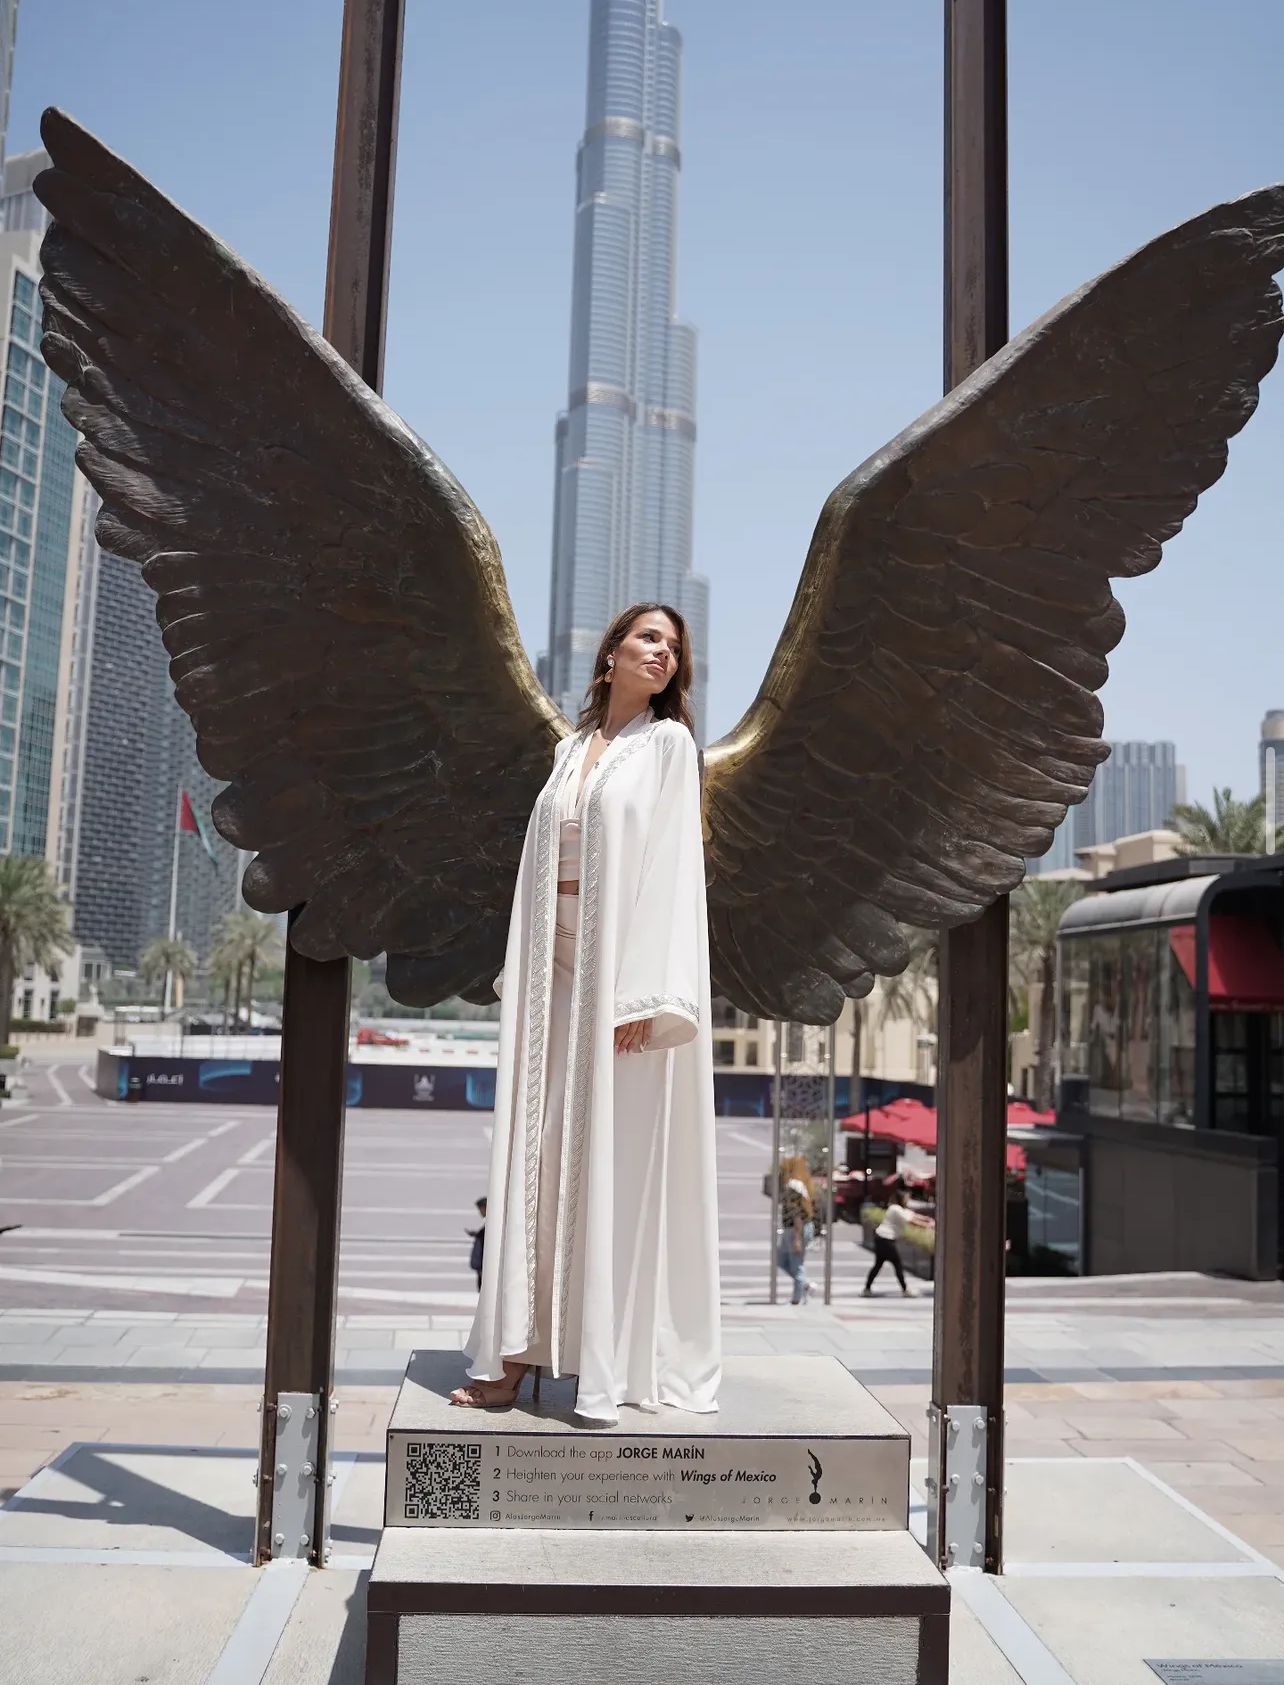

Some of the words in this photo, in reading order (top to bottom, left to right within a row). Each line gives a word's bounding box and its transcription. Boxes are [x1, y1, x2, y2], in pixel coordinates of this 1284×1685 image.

[495, 1445, 500, 1457] 1
[507, 1445, 566, 1459] Download
[569, 1446, 587, 1459] the
[589, 1449, 613, 1462] app
[616, 1447, 658, 1460] JORGE
[662, 1445, 705, 1460] MARÍN
[493, 1468, 501, 1480] 2
[507, 1468, 557, 1484] Heighten
[560, 1472, 584, 1484] your
[588, 1470, 649, 1484] experience
[653, 1470, 676, 1482] with
[680, 1470, 717, 1485] Wings
[720, 1470, 733, 1482] of
[735, 1470, 777, 1483] Mexico
[492, 1491, 500, 1502] 3
[506, 1490, 539, 1503] Share
[544, 1491, 553, 1503] in
[557, 1494, 583, 1506] your
[586, 1493, 619, 1503] social
[623, 1494, 673, 1504] networks
